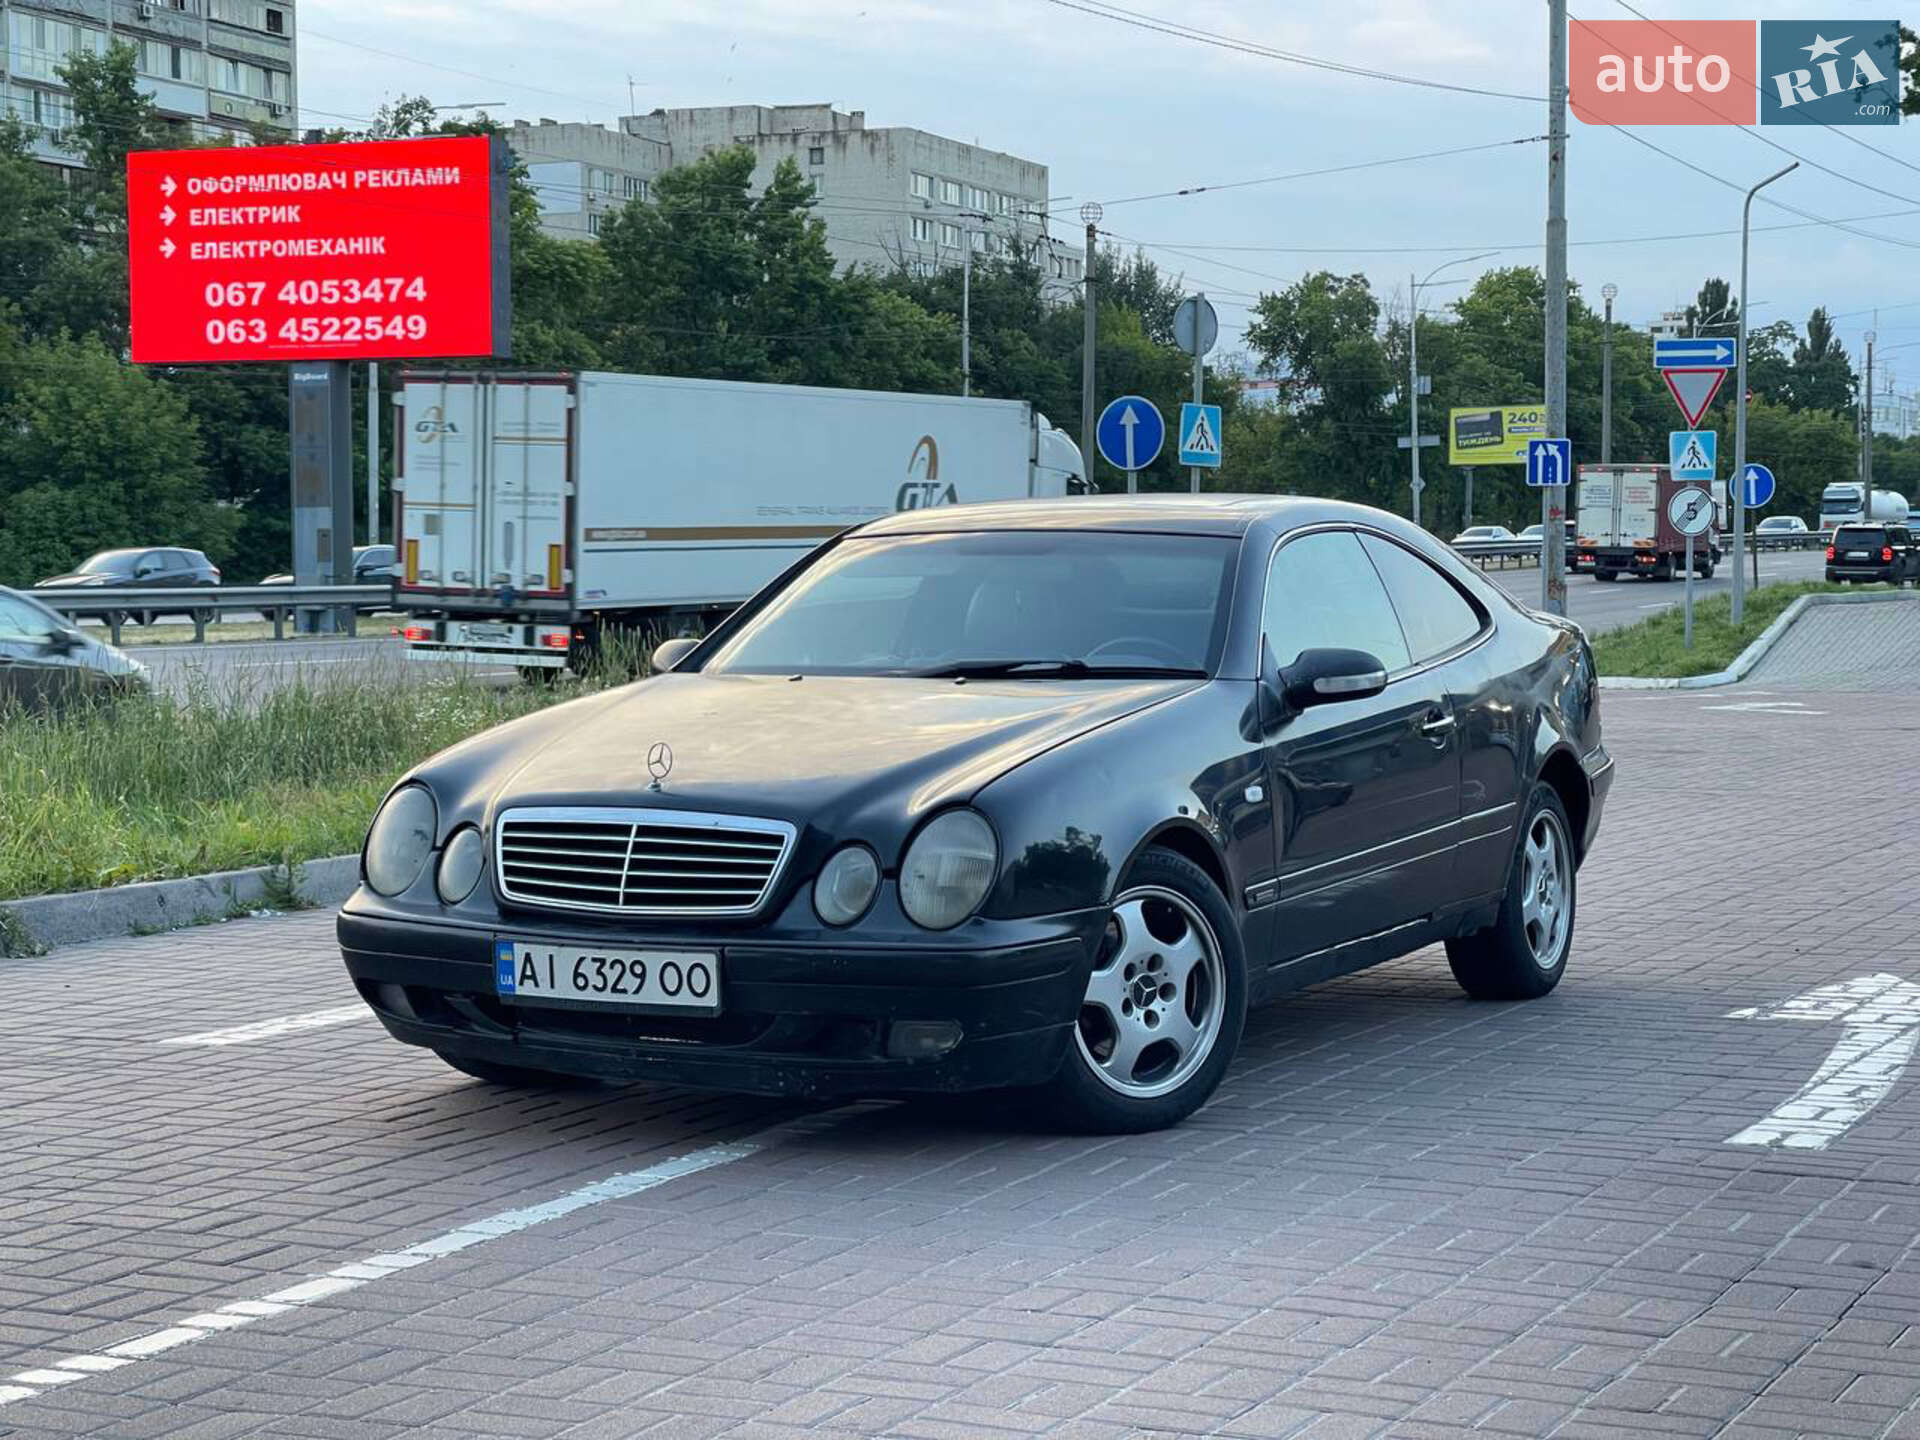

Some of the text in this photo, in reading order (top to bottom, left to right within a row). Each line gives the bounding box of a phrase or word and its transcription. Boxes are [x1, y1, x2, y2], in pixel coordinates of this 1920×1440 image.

[187, 167, 461, 195] ОФОРМЛЮВАЧ РЕКЛАМИ
[189, 206, 301, 227] ЕЛЕКТРИК
[190, 236, 387, 260] ЕЛЕКТРОМЕХАНІК
[205, 276, 427, 308] 067 4053474
[206, 315, 427, 344] 063 4522549
[896, 482, 959, 513] GTA
[1686, 502, 1698, 520] 5
[500, 974, 514, 986] UA
[518, 952, 555, 989] AI
[573, 956, 648, 995] 6329
